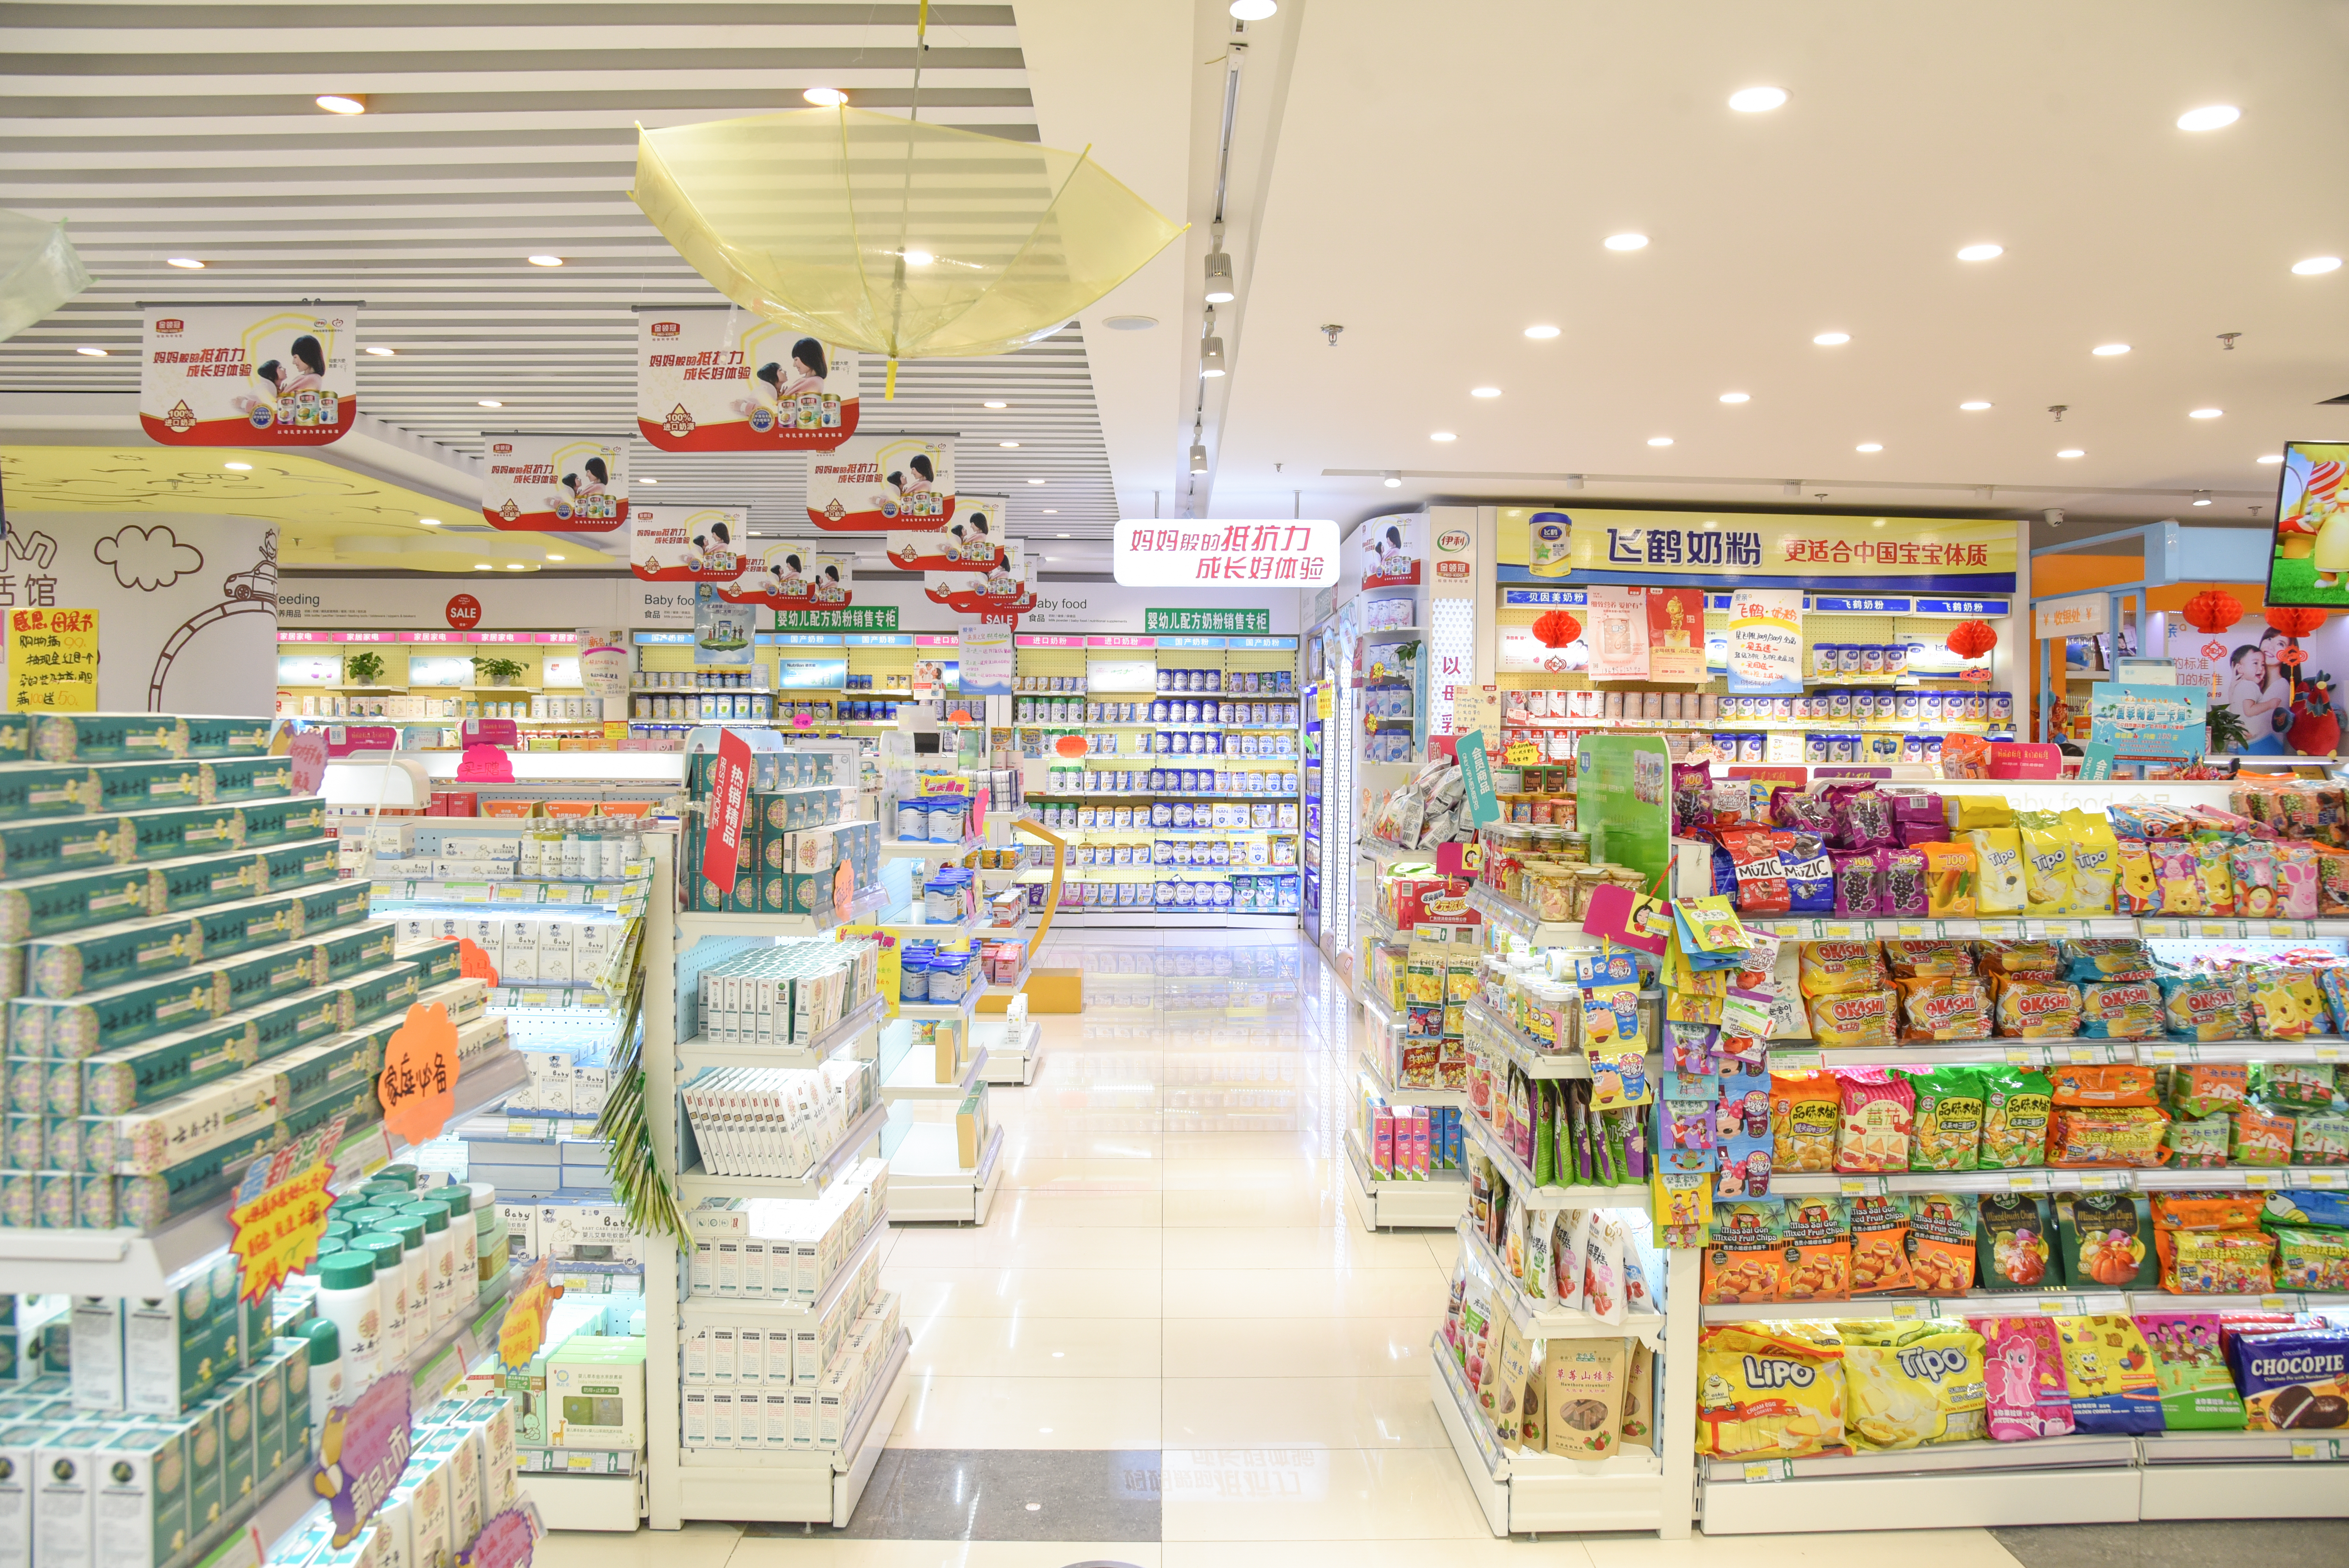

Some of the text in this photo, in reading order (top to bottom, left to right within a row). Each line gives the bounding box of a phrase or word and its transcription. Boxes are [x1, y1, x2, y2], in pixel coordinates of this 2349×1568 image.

[654, 324, 677, 333] 金领冠
[153, 348, 245, 363] 妈妈般的抵抗力
[649, 351, 744, 367] 妈妈般的抵力
[186, 364, 252, 377] 成长好体验
[683, 366, 751, 380] 成长好体验
[164, 419, 197, 427] 进口奶源
[666, 413, 692, 422] 100%
[663, 422, 695, 431] 进口奶源
[491, 464, 554, 474] 妈妈般的抵抗力
[814, 463, 879, 474] 妈妈般的抵抗力
[838, 474, 883, 483] 成长好体验
[1130, 525, 1311, 551] 妈妈般的抵抗力
[1441, 535, 1465, 547] 伊利
[1607, 528, 1988, 567] 飞鹤奶粉 更适合中国宝宝体质
[1196, 556, 1324, 579] 成长好体验
[1440, 563, 1466, 573] 金领冠
[277, 593, 320, 607] eeding
[645, 594, 695, 608] Baby foo
[1529, 592, 1584, 602] 贝因美奶粉
[1034, 599, 1087, 611] aby food
[1842, 600, 1884, 609] 飞鹤奶粉
[1942, 602, 1983, 612] 飞鹤奶粉
[450, 608, 476, 618] SALE
[644, 610, 660, 618] 食品
[777, 610, 896, 627] 婴幼儿配方奶粉销售专柜
[1028, 614, 1045, 622] 食品
[2054, 608, 2082, 625] 收银处
[986, 615, 1013, 625] SALE
[1148, 612, 1267, 631] 婴幼儿配方奶粉销售专柜
[280, 633, 514, 641] 家居家电 家居家电 家居家电 家居家电
[791, 634, 895, 644] 国产奶粉 国产奶粉
[933, 636, 1280, 647] 进口奶 进口奶粉 进口奶粉 国产奶粉 国产奶粉
[1746, 642, 1779, 653] 买五送一
[1745, 661, 1774, 670] 买四送一
[2116, 703, 2187, 722] 夏季畅游一卡通
[1472, 747, 1490, 795] 会员商品
[1684, 773, 1703, 786] 100
[713, 756, 727, 827] BEST CHOICE
[1468, 778, 1479, 811] MEMBERS
[722, 764, 744, 849] 热销精品
[1853, 856, 1873, 867] 100
[1897, 854, 1918, 864] 100
[1946, 854, 1966, 866] 100
[2032, 850, 2066, 872] Tipo
[2075, 850, 2107, 870] Tipo
[554, 938, 571, 946] Baby
[1817, 941, 1866, 960] OKASHI
[1608, 966, 1632, 978] 想象力
[1613, 1000, 1638, 1014] 想象力
[1832, 997, 1884, 1020] OKASHI
[1924, 994, 1976, 1017] OKASHI
[2018, 994, 2070, 1014] OKASHI
[1768, 1004, 1792, 1017] 눈송이
[384, 1052, 447, 1107] 家庭必备
[1743, 1100, 1769, 1112] 想象力
[1866, 1108, 1901, 1124] 蕃茄
[1747, 1161, 1771, 1173] 想象力
[1790, 1221, 1809, 1229] Miss
[1914, 1214, 1962, 1228] Miss Sai Gon
[1783, 1229, 1807, 1238] Mixed
[1930, 1224, 1970, 1237] Fruit Chips
[1713, 1233, 1738, 1242] Mixed
[1756, 1233, 1777, 1242] Chips
[1914, 1232, 1958, 1244] 西贡小姐综合果蔬干
[1896, 1345, 1968, 1384] Tipo
[2251, 1354, 2344, 1376] CHOCOPIE
[1555, 1368, 1615, 1382] 草莓山楂条
[1962, 1392, 1984, 1401] COOKIES
[1746, 1404, 1763, 1415] CREAM
[1754, 1407, 1773, 1416] COOKIES
